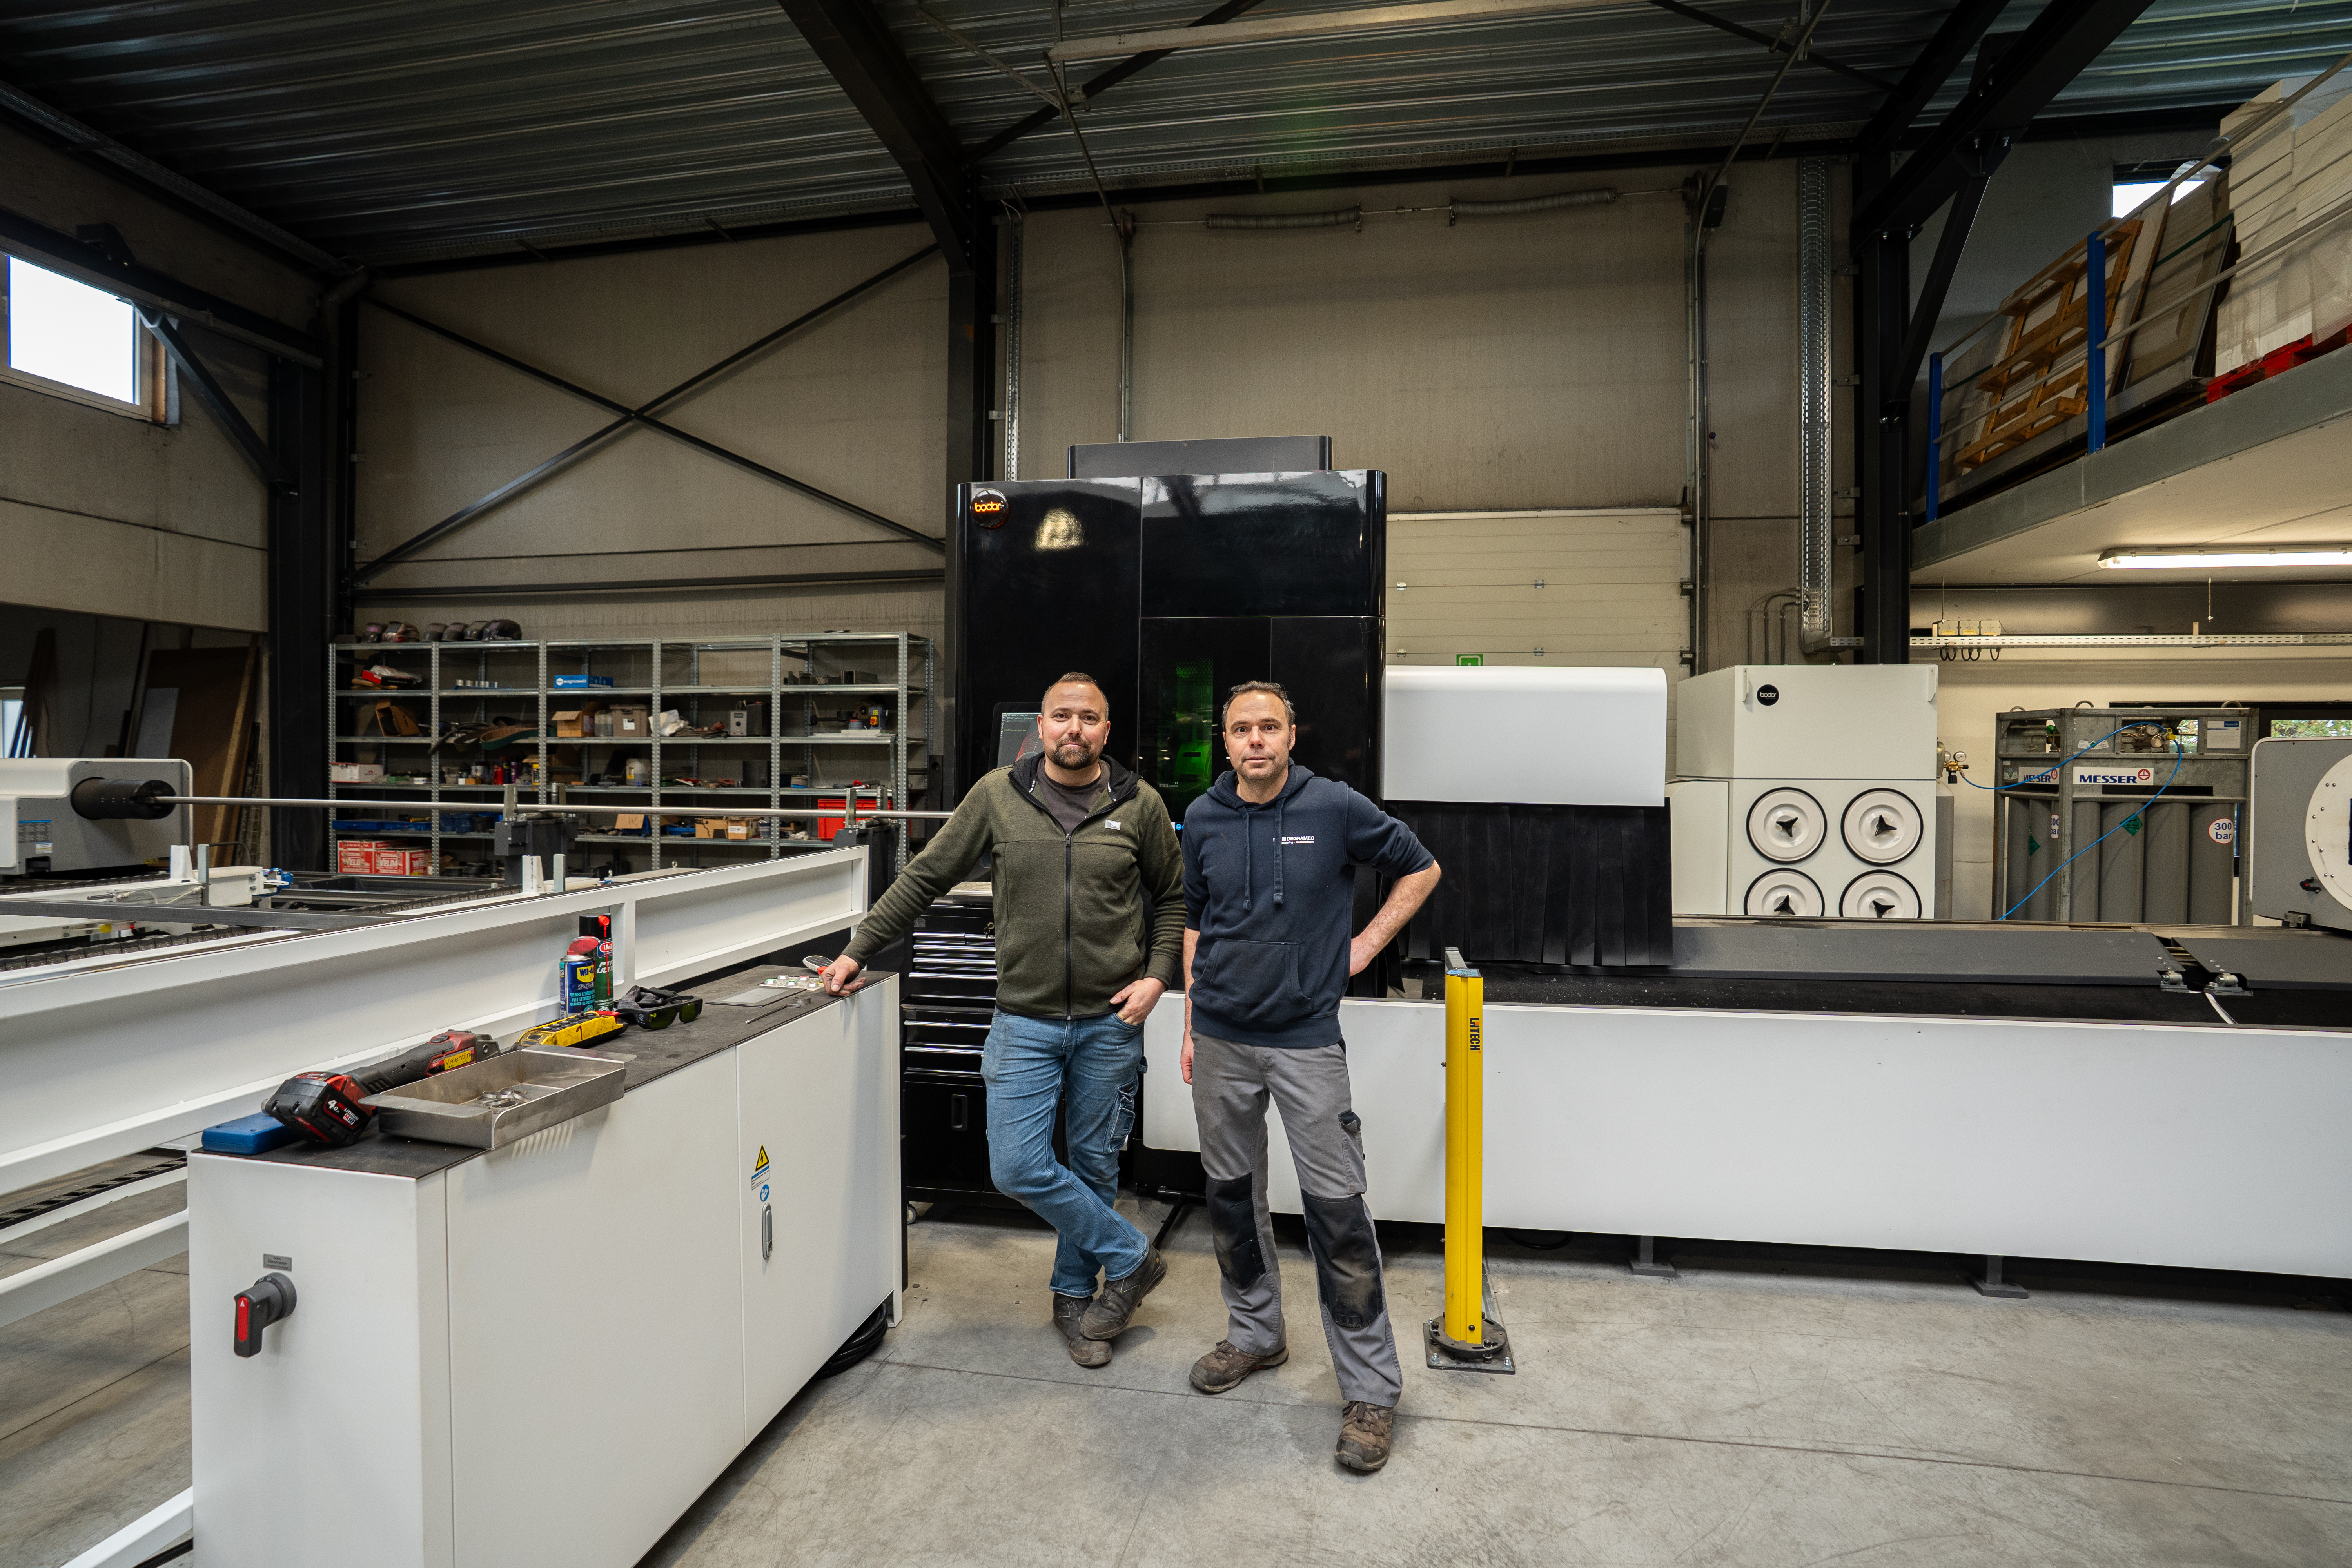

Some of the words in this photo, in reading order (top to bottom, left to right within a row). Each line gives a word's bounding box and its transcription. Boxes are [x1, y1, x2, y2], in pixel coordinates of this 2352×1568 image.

[975, 501, 1001, 512] bodor
[2024, 774, 2051, 783] MESER
[2079, 775, 2137, 784] MESSER
[579, 966, 594, 976] WD-40
[445, 1052, 471, 1065] Valentijn
